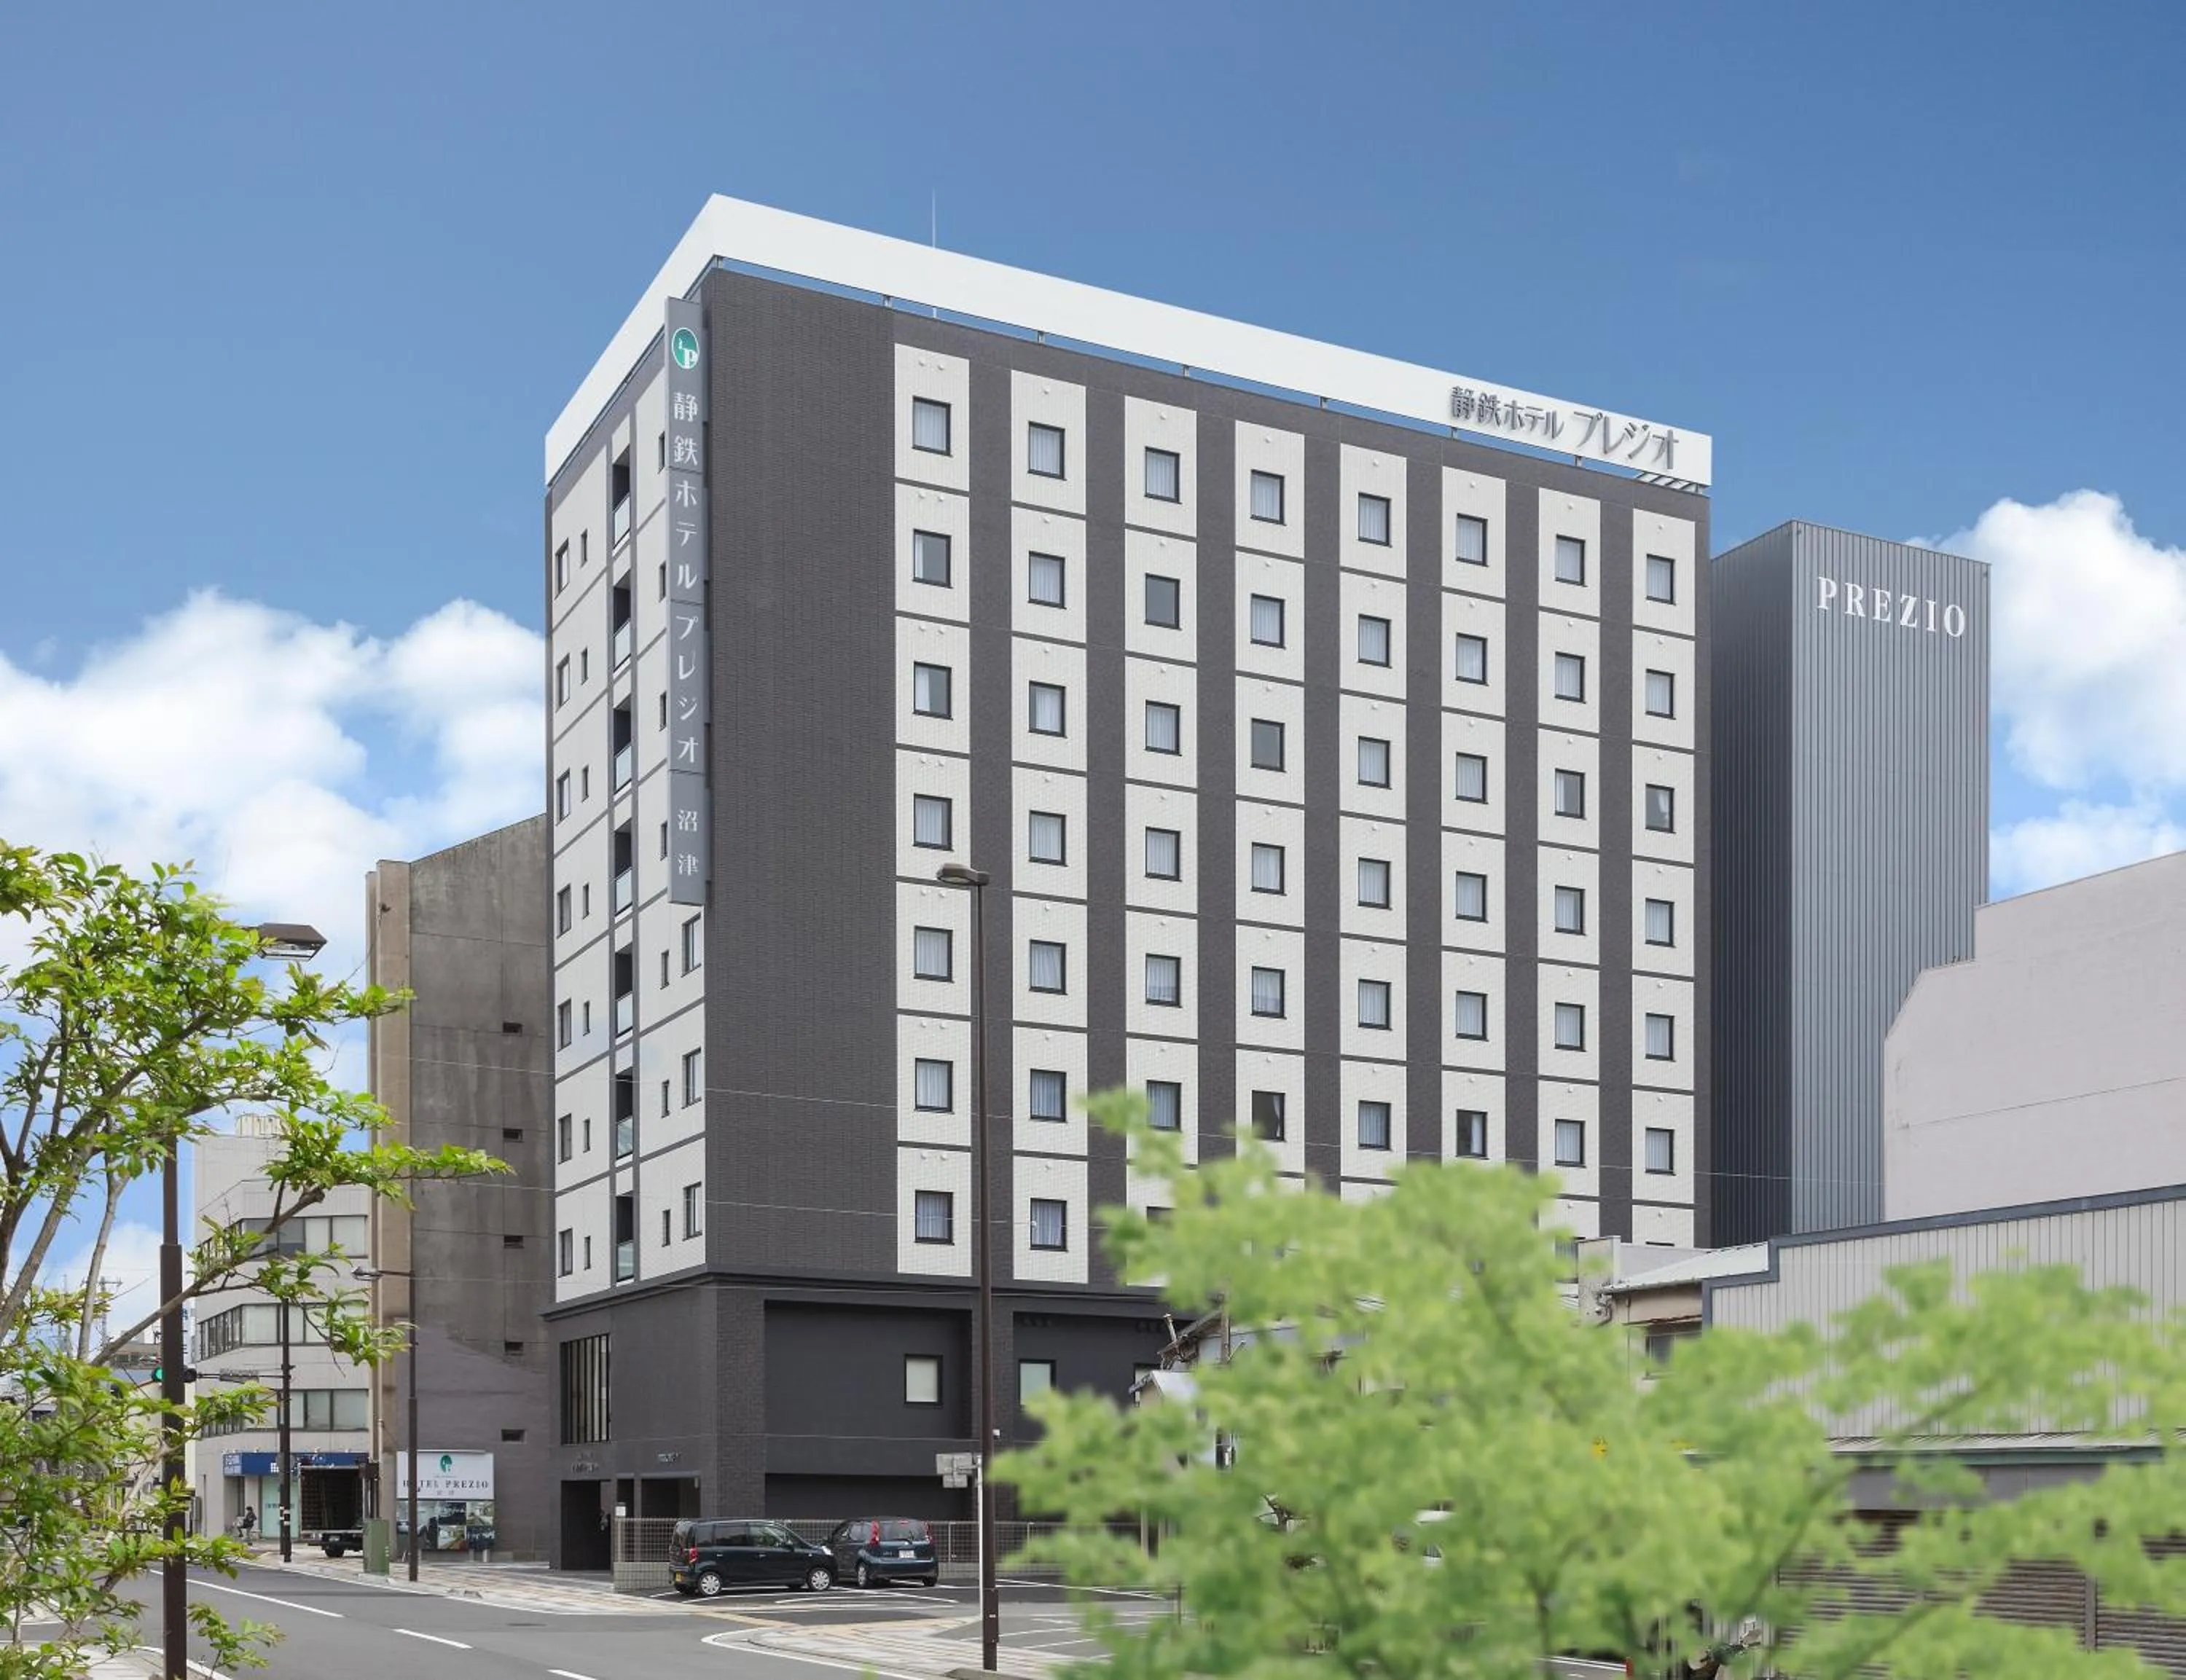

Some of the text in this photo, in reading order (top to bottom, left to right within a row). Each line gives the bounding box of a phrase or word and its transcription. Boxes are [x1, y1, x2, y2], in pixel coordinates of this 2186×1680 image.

[1817, 576, 1965, 637] PREZIO
[403, 1480, 489, 1488] HTEL PREZIO
